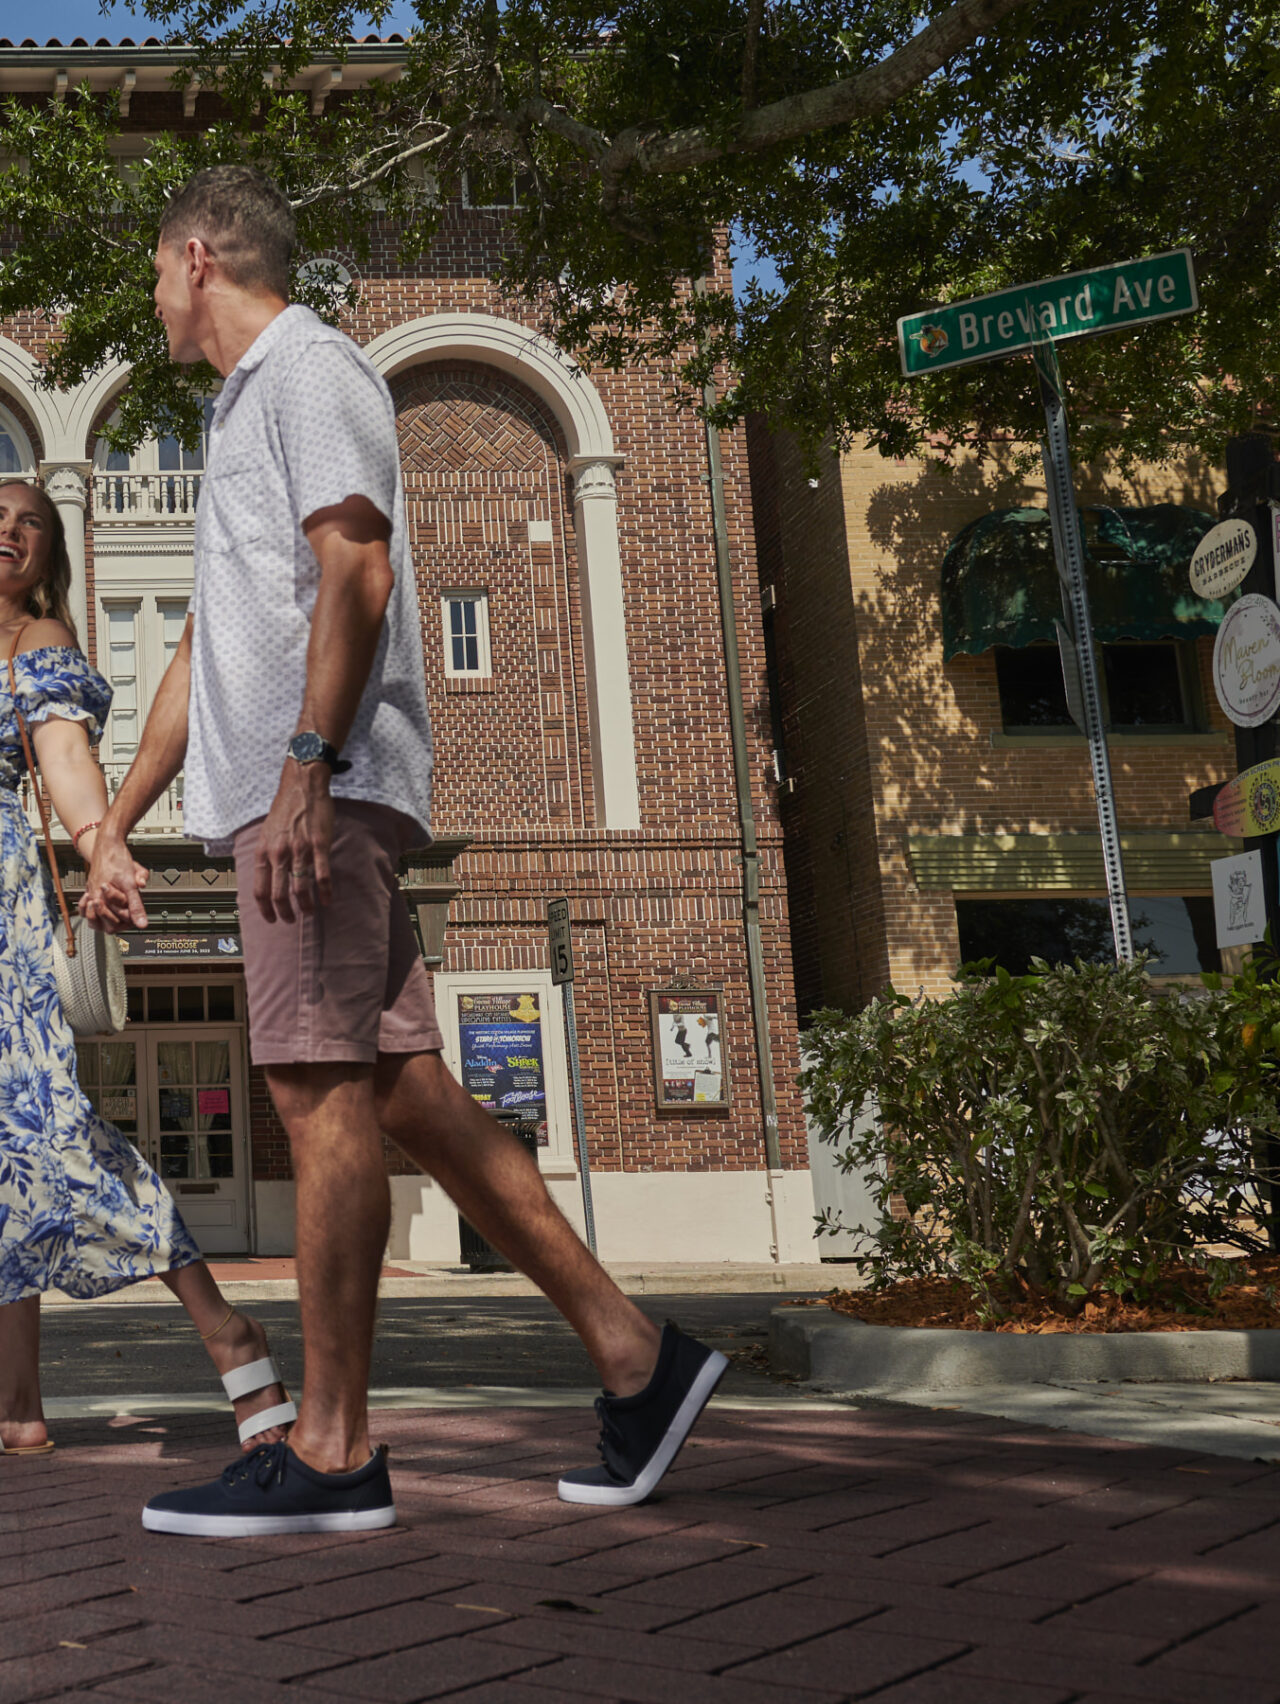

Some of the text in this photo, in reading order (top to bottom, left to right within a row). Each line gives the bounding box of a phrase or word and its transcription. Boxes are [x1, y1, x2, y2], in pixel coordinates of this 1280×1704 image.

[959, 274, 1176, 350] Brevard Ave
[1202, 556, 1246, 586] BARBECUE
[1224, 636, 1269, 671] Maven
[553, 944, 568, 975] 15
[464, 1058, 497, 1068] Aladdin
[499, 1090, 544, 1108] Footloose
